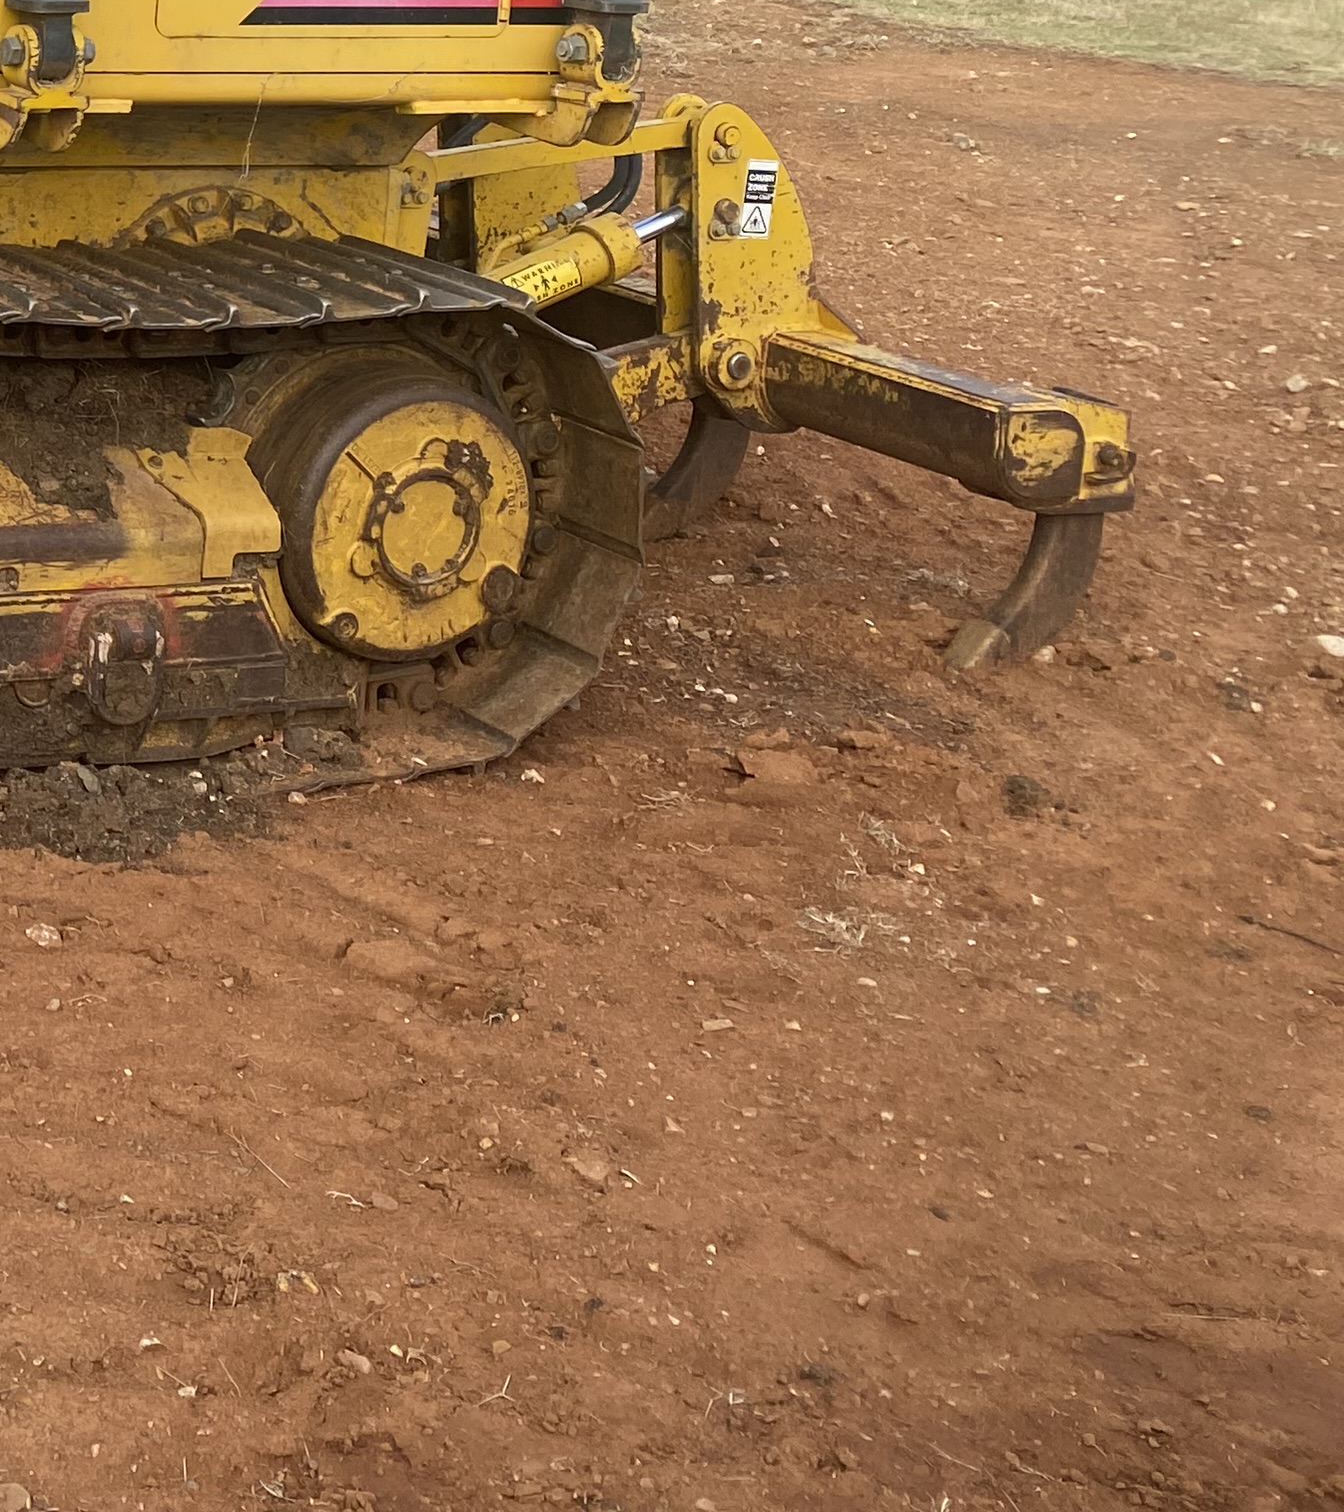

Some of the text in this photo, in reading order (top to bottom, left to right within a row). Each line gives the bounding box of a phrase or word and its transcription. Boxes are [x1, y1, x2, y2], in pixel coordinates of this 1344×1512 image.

[749, 174, 775, 182] CRUSH
[521, 259, 567, 281] WARNI
[553, 278, 578, 294] ZONE
